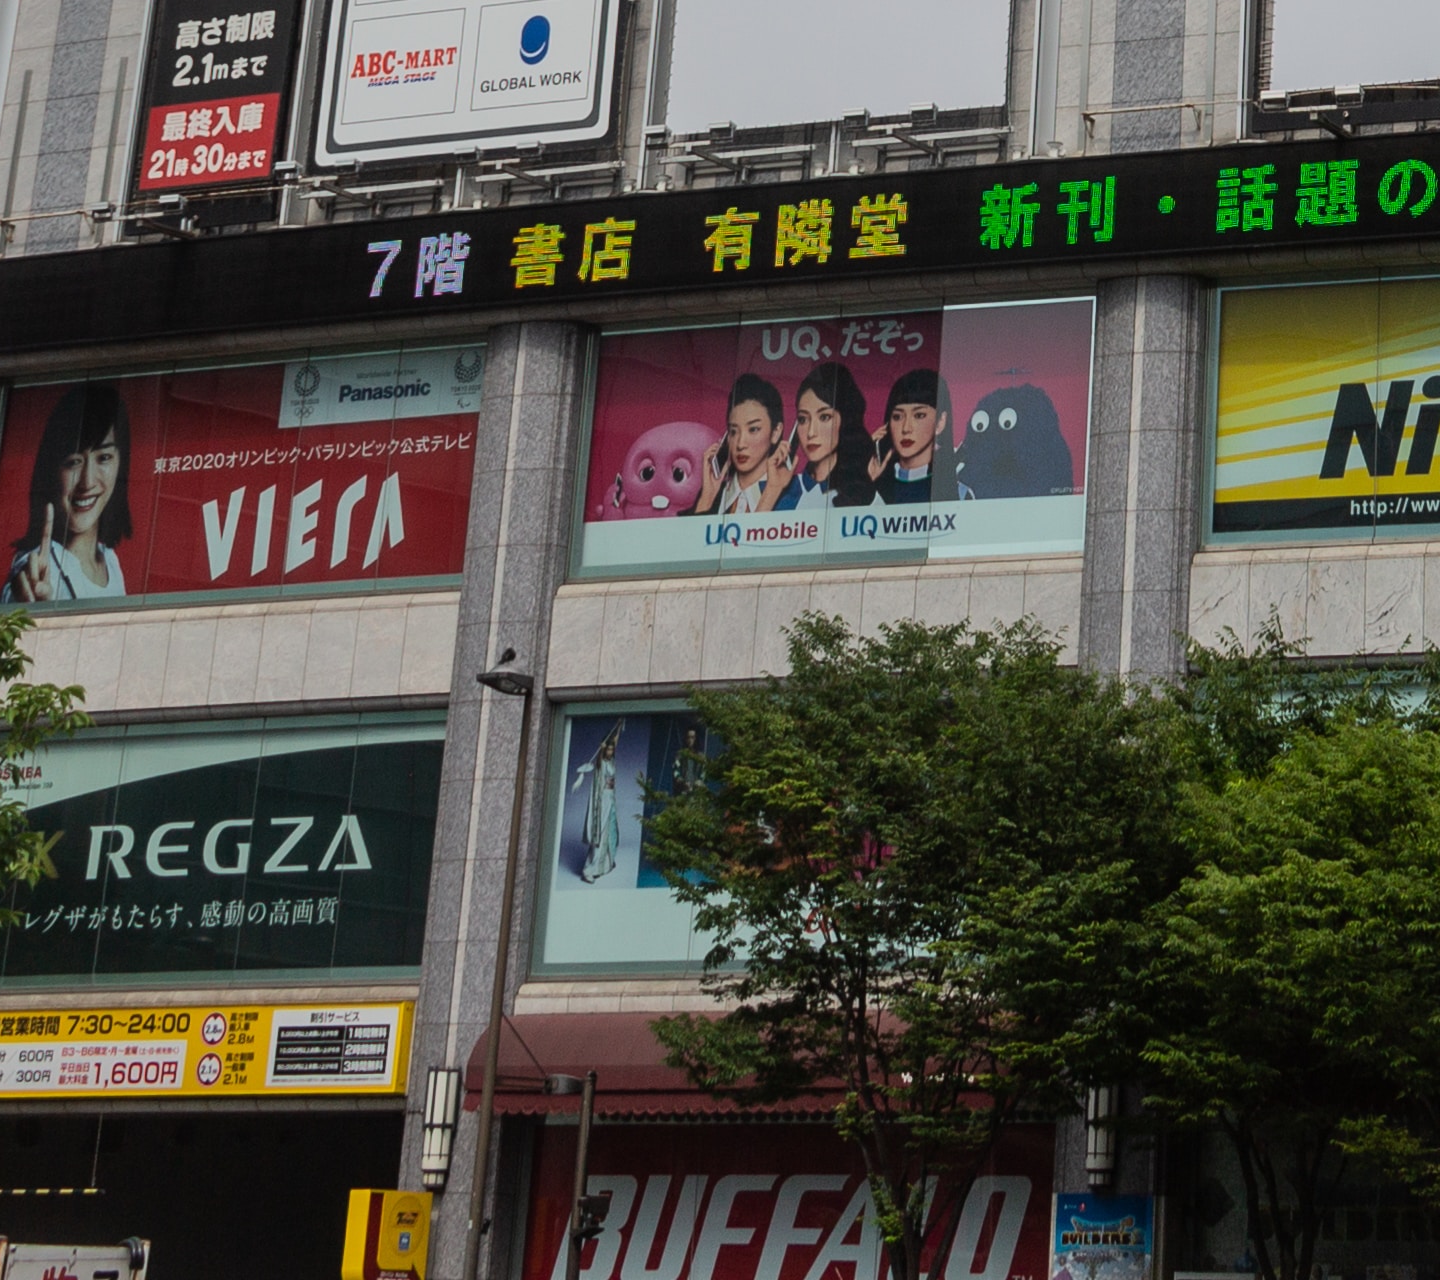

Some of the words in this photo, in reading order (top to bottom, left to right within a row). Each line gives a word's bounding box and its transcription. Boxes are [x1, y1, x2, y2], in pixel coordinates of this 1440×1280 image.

[174, 8, 277, 49] 高さ制限
[171, 54, 270, 89] 2.1mまで
[350, 45, 458, 81] ABC-MART
[366, 74, 401, 89] MEGA
[401, 69, 437, 86] STAGE
[479, 73, 537, 95] GLOBAL
[538, 68, 583, 88] WORK
[161, 102, 264, 144] 最終入庫
[146, 142, 268, 181] 21時30分まで
[760, 320, 924, 363] UQ、だぞっ
[337, 378, 432, 403] Panasonic
[153, 432, 474, 475] 東京2020オリンピック・パラリンピック公式テレビ
[705, 522, 742, 547] UQ
[745, 520, 820, 544] mobile
[840, 513, 879, 540] UQ
[881, 512, 958, 535] WiMAX
[84, 814, 374, 881] REGZA
[24, 896, 340, 934] レグザがもたらす、感動の高画質
[310, 1011, 361, 1025] 割引サービス
[93, 1061, 179, 1088] 1,600円
